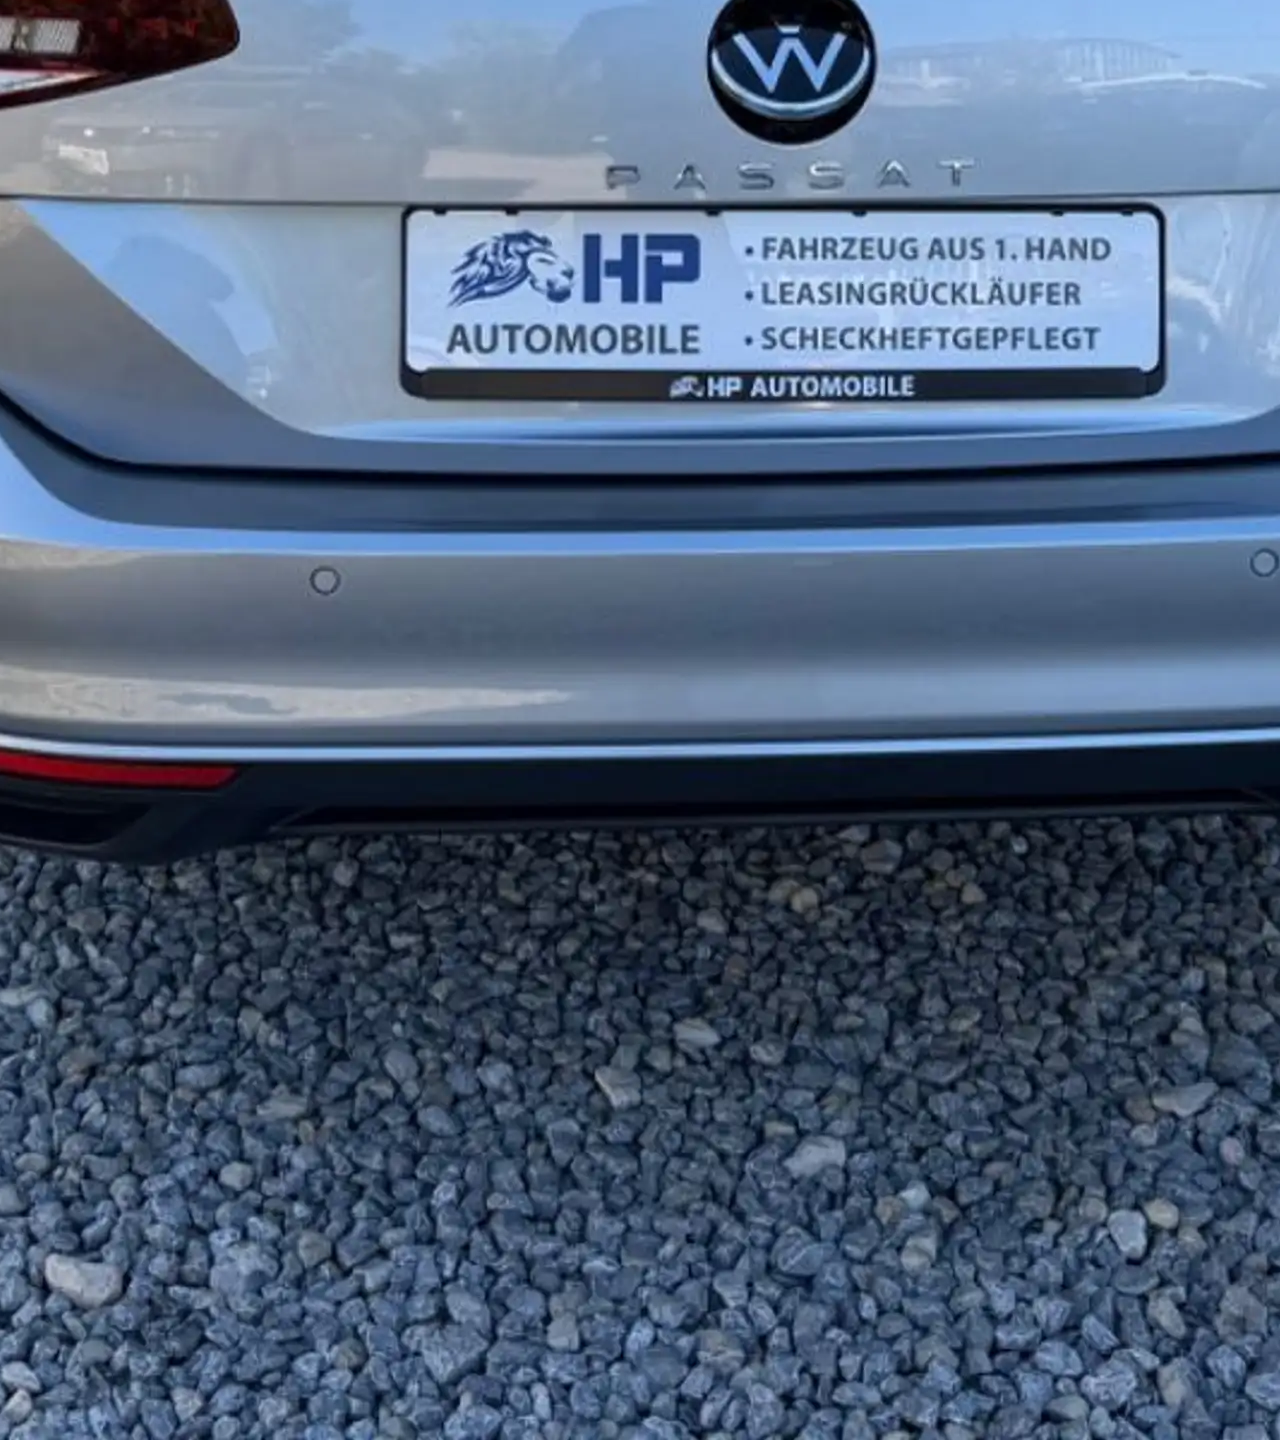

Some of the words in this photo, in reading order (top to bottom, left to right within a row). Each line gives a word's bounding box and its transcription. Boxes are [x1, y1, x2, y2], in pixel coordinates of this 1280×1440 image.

[605, 159, 976, 192] PASSAT
[761, 236, 920, 262] FAHRZEUG
[927, 236, 986, 262] AUS
[995, 237, 1018, 261] 1.
[1024, 237, 1112, 262] HAND
[582, 232, 702, 304] HP
[761, 276, 1082, 307] LEASINGRÜCKLÄUFER
[446, 323, 701, 356] AUTOMOBILE
[760, 326, 1102, 351] SCHECKHEFTGEPFLEGT
[706, 375, 742, 398] HP
[749, 374, 917, 398] AUTOMOBILE
